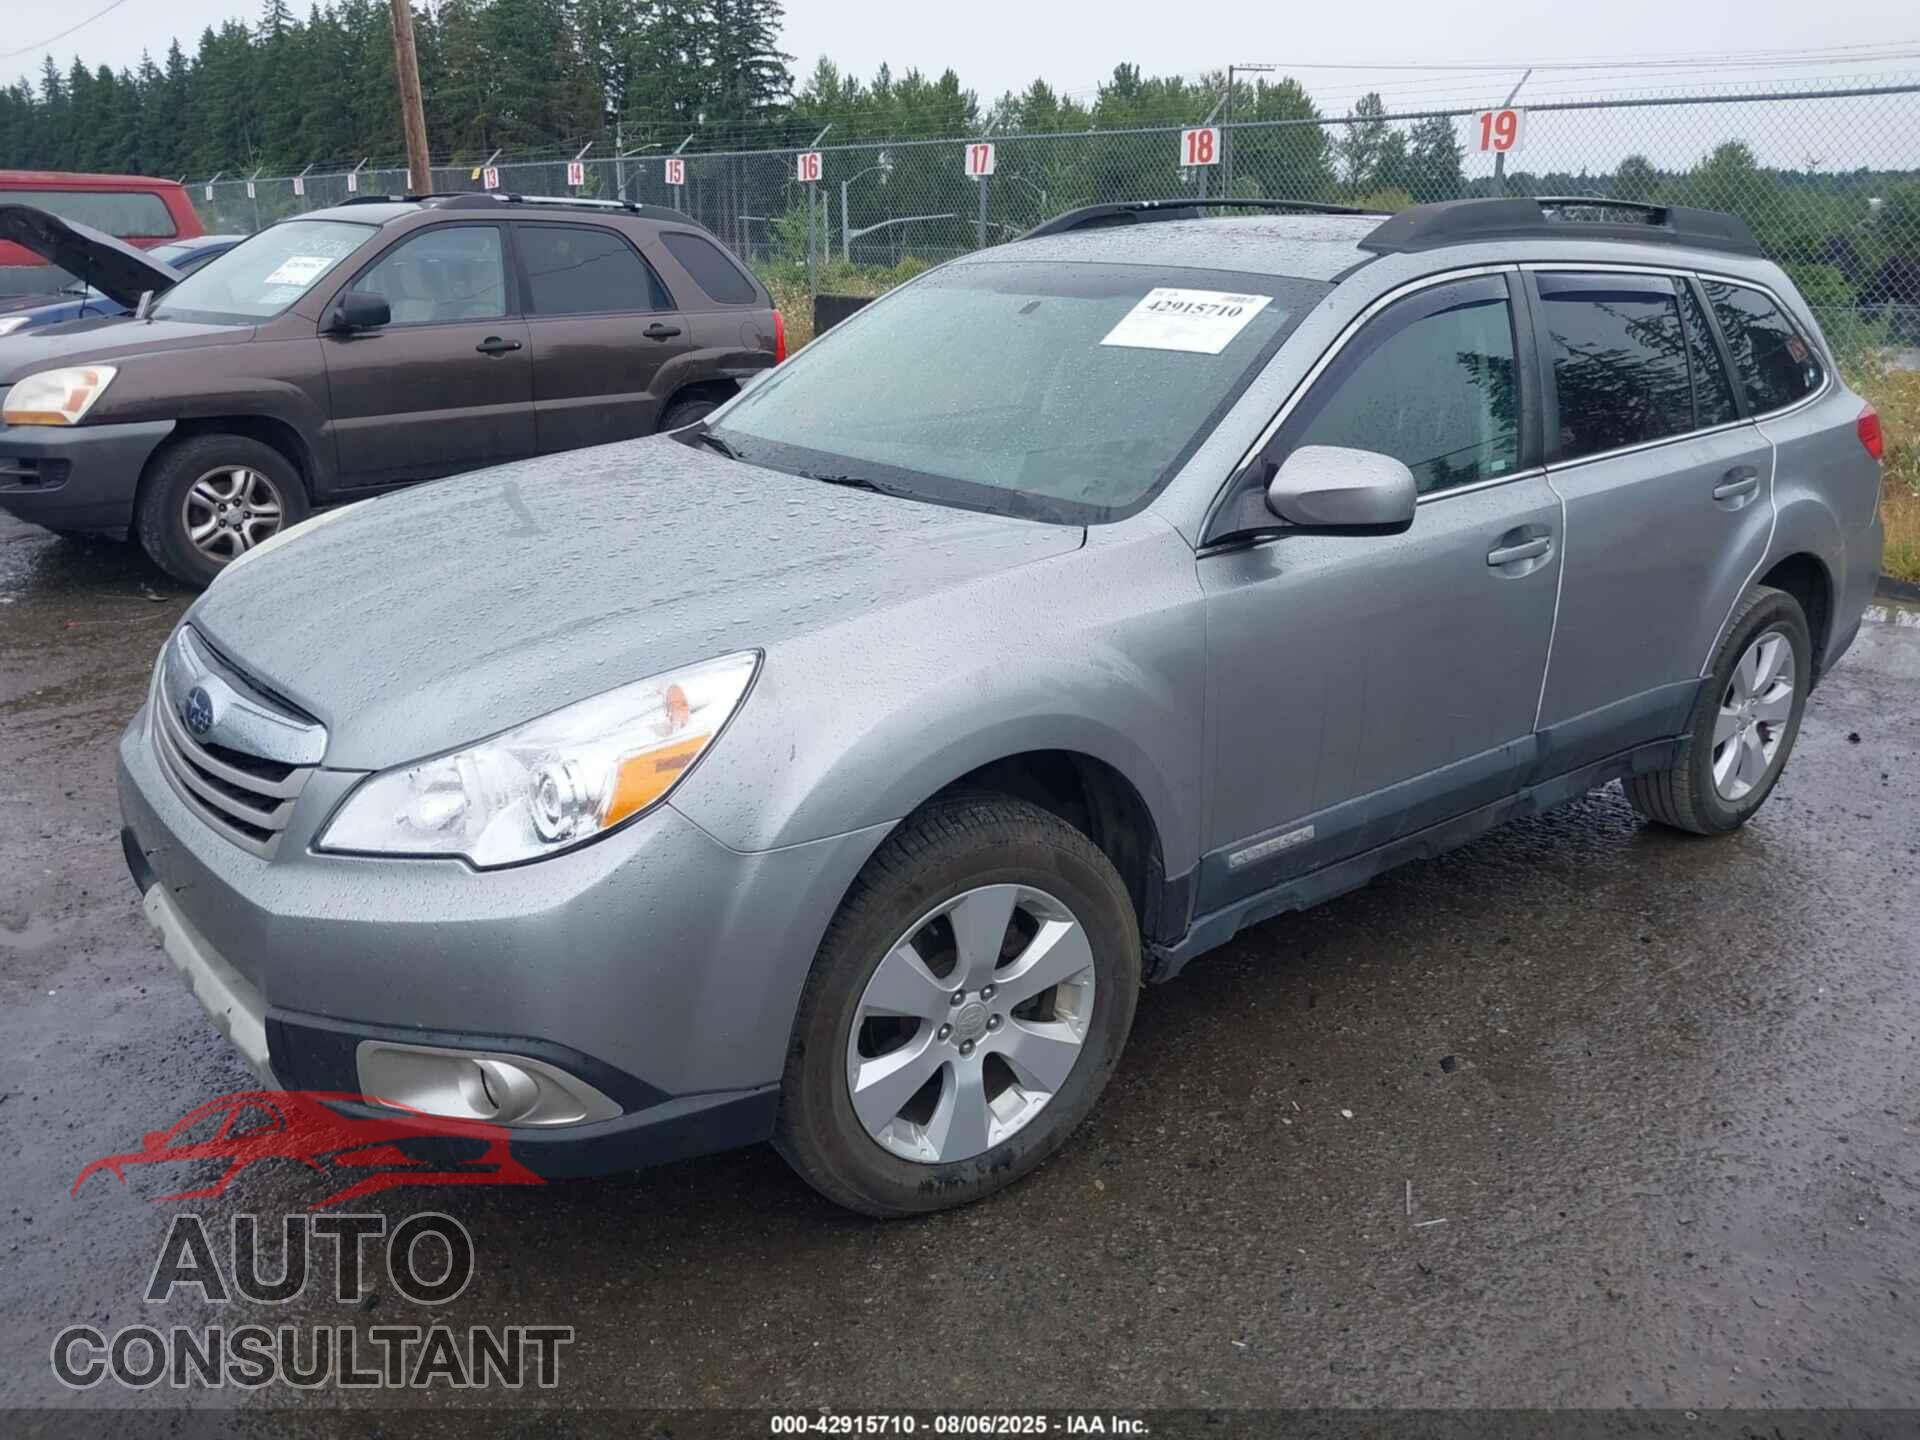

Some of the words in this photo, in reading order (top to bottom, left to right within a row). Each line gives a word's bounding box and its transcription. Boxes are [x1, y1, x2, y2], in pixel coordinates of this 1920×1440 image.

[1480, 110, 1517, 151] 19
[972, 144, 989, 174] 17
[1187, 130, 1214, 164] 18
[486, 169, 497, 188] 13
[570, 163, 582, 184] 14
[668, 160, 682, 183] 15
[801, 154, 818, 179] 16
[1147, 299, 1244, 318] 42915710
